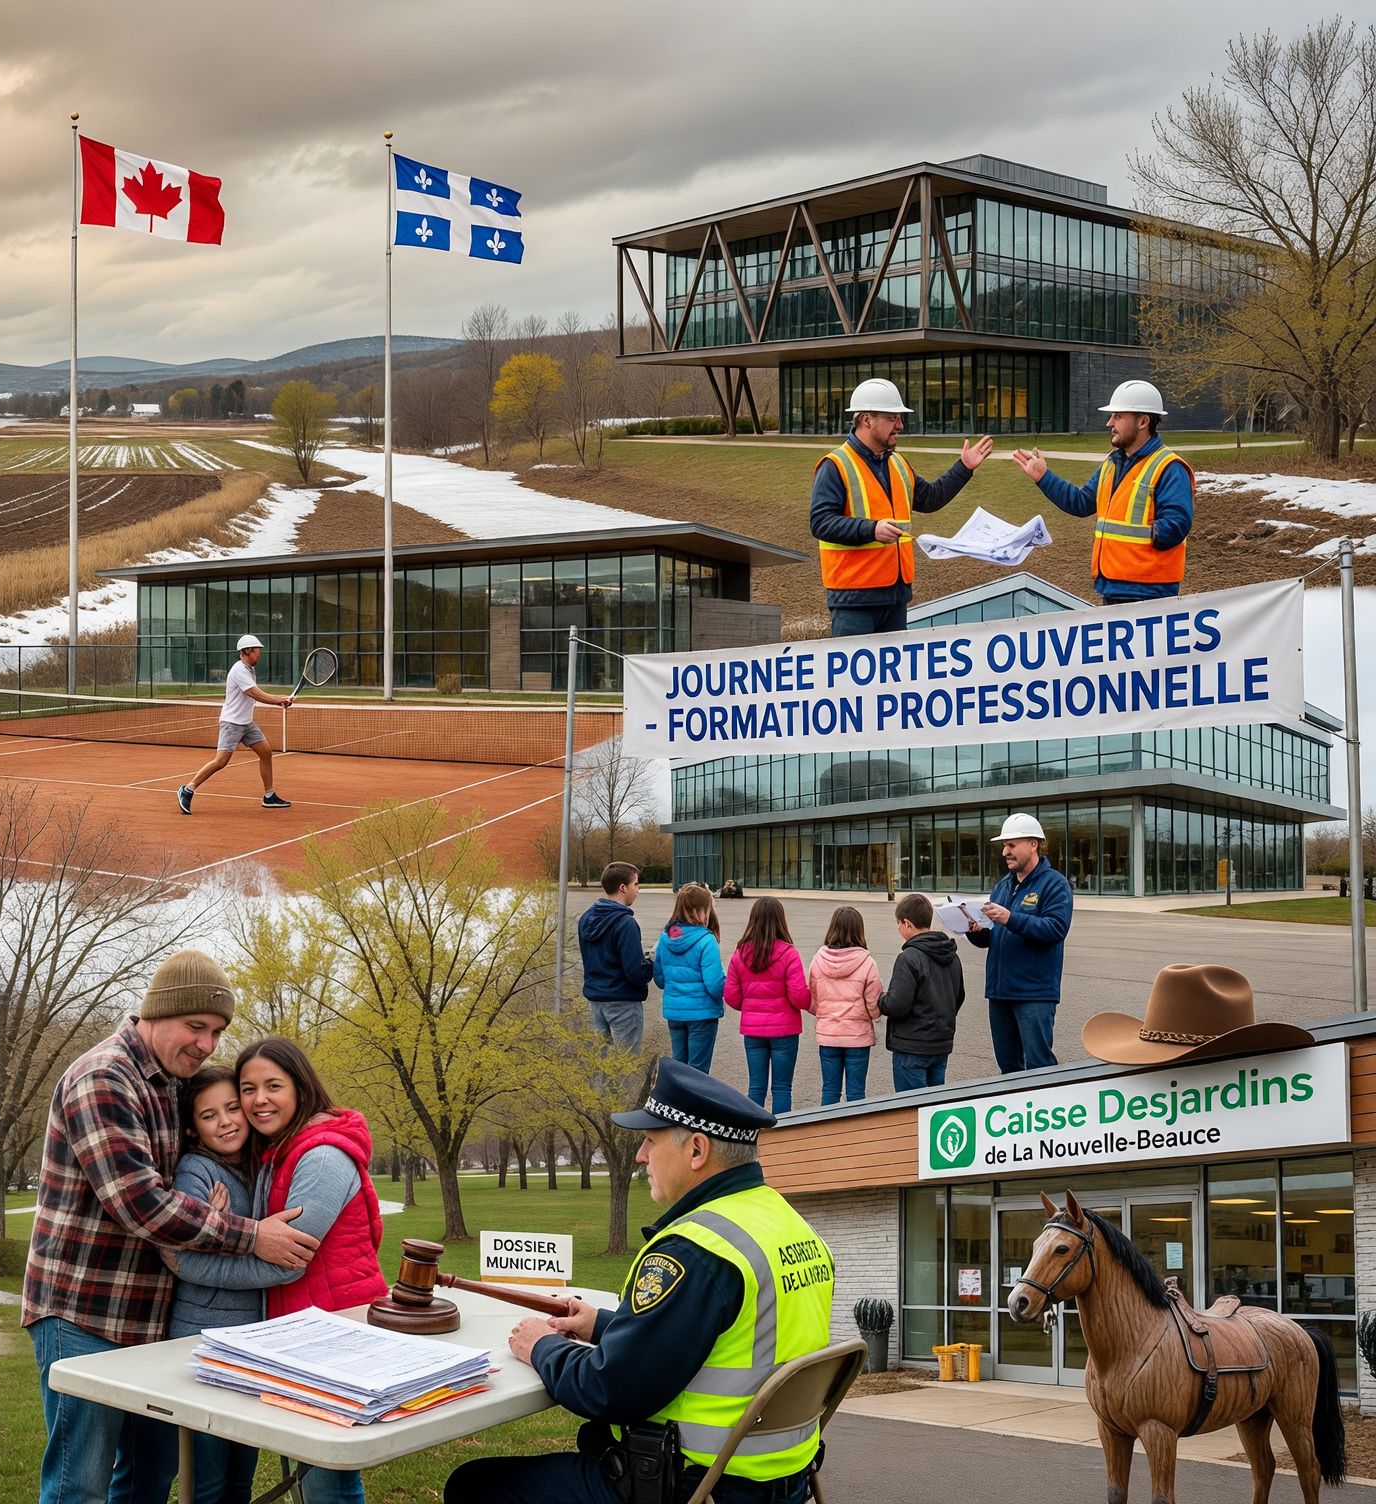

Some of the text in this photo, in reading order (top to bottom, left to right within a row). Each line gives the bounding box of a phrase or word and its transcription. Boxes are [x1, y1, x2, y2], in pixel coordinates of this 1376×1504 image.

[666, 609, 1221, 699] JOURNÉE PORTES OUVERTES
[669, 696, 863, 742] FORMATION
[877, 657, 1269, 731] PROFESSIONNELLE
[985, 1069, 1314, 1138] Caisse Desjardins
[985, 1125, 1221, 1165] de La Nouvelle-Beauce
[486, 1256, 565, 1272] MUNICIPAL
[493, 1239, 557, 1254] DOSSIER
